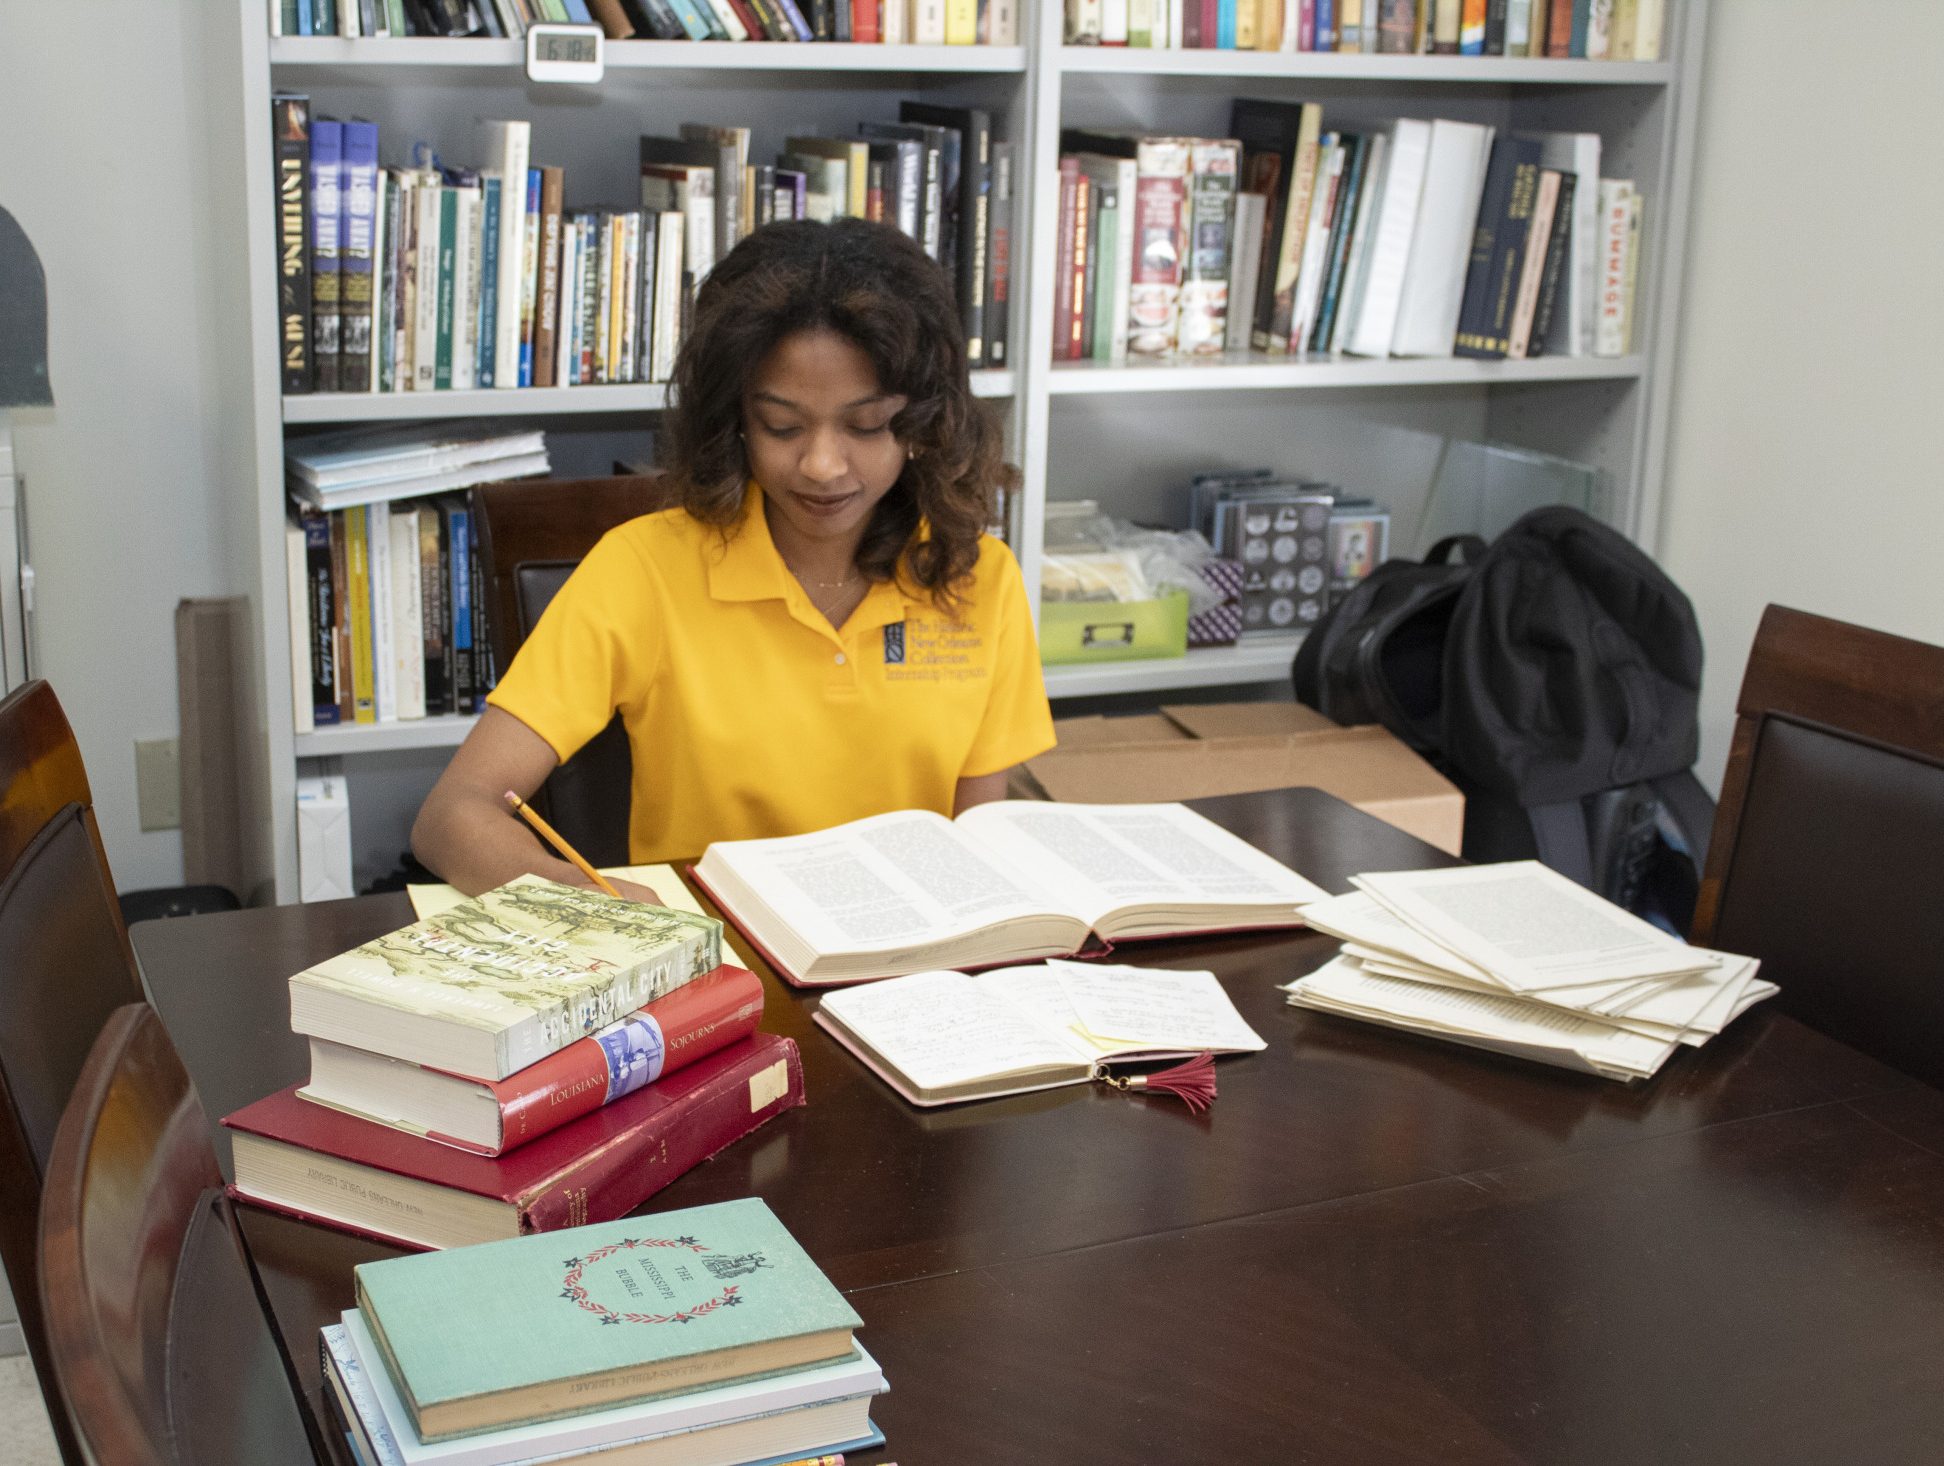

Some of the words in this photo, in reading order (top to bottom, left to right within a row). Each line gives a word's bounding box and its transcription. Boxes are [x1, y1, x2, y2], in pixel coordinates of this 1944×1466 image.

[1602, 206, 1626, 319] RUMMAGE
[911, 636, 935, 649] New
[411, 932, 594, 981] ACCIDENTAL
[540, 984, 633, 1045] ACCIDENTAL
[638, 962, 672, 995] CITY
[549, 1072, 606, 1107] LOUISIANA
[669, 1023, 716, 1051] SOJOURNS
[306, 1168, 339, 1187] LIBRARY
[338, 1180, 369, 1198] PUBLIC
[562, 1188, 573, 1200] of
[615, 1268, 644, 1298] BUBBLE
[638, 1257, 676, 1300] MISSISSIPPI
[674, 1265, 694, 1283] THE
[569, 1380, 616, 1394] LIBRARY
